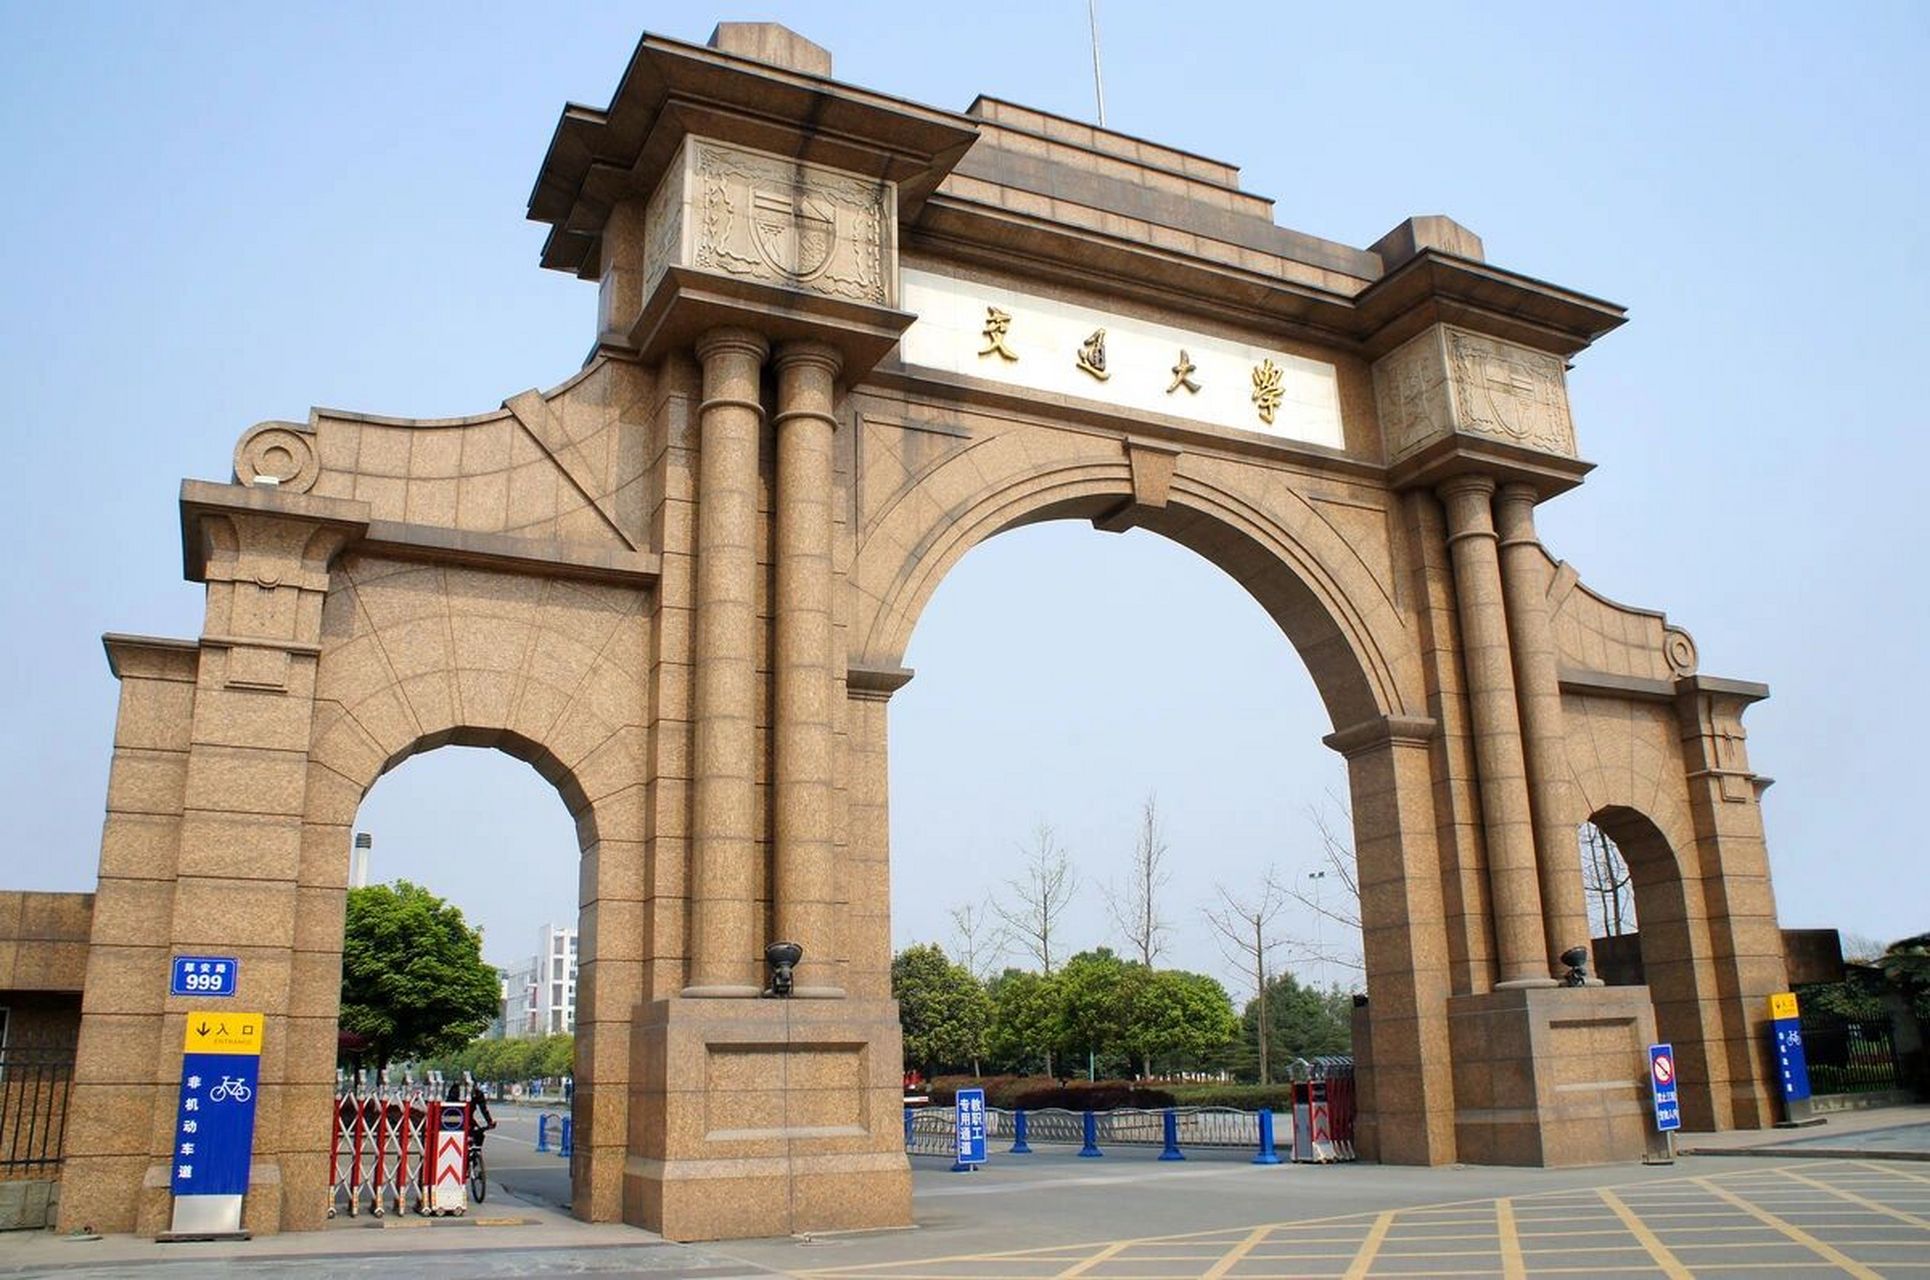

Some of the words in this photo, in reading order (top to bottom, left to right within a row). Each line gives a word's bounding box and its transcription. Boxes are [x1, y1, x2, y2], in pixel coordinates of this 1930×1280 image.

[186, 974, 222, 990] 999
[217, 1023, 254, 1036] 入口
[178, 1076, 202, 1178] 非机动车道
